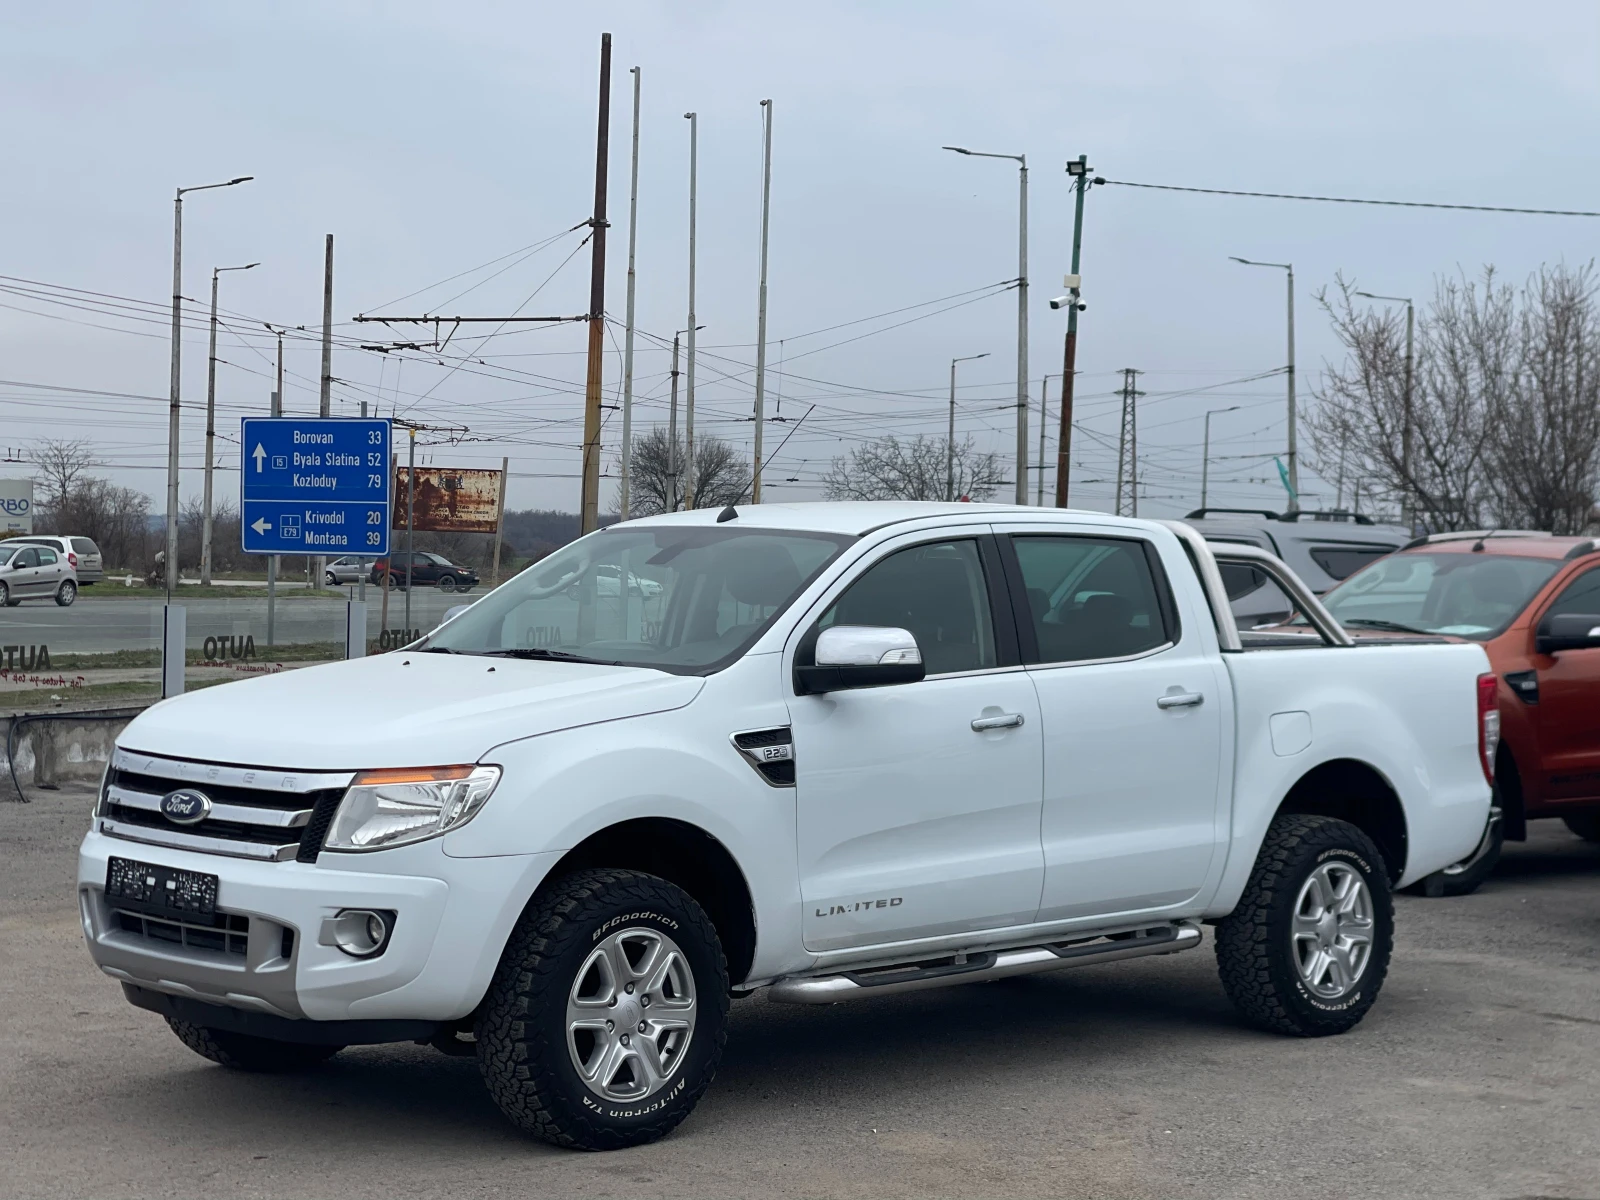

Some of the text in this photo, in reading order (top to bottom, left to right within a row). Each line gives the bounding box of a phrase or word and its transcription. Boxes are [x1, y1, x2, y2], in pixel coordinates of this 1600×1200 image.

[293, 431, 381, 444] Borovan 33
[276, 458, 283, 466] 15
[293, 452, 381, 469] Byala Slatina 52
[293, 474, 381, 490] Kozloduy 79
[305, 510, 381, 525] Krivodol 20
[283, 528, 297, 537] E79
[305, 531, 381, 545] Montana 39
[166, 794, 195, 814] Ford
[592, 911, 679, 941] BFGoodrich
[582, 1077, 685, 1119] All-Terrain T/A
